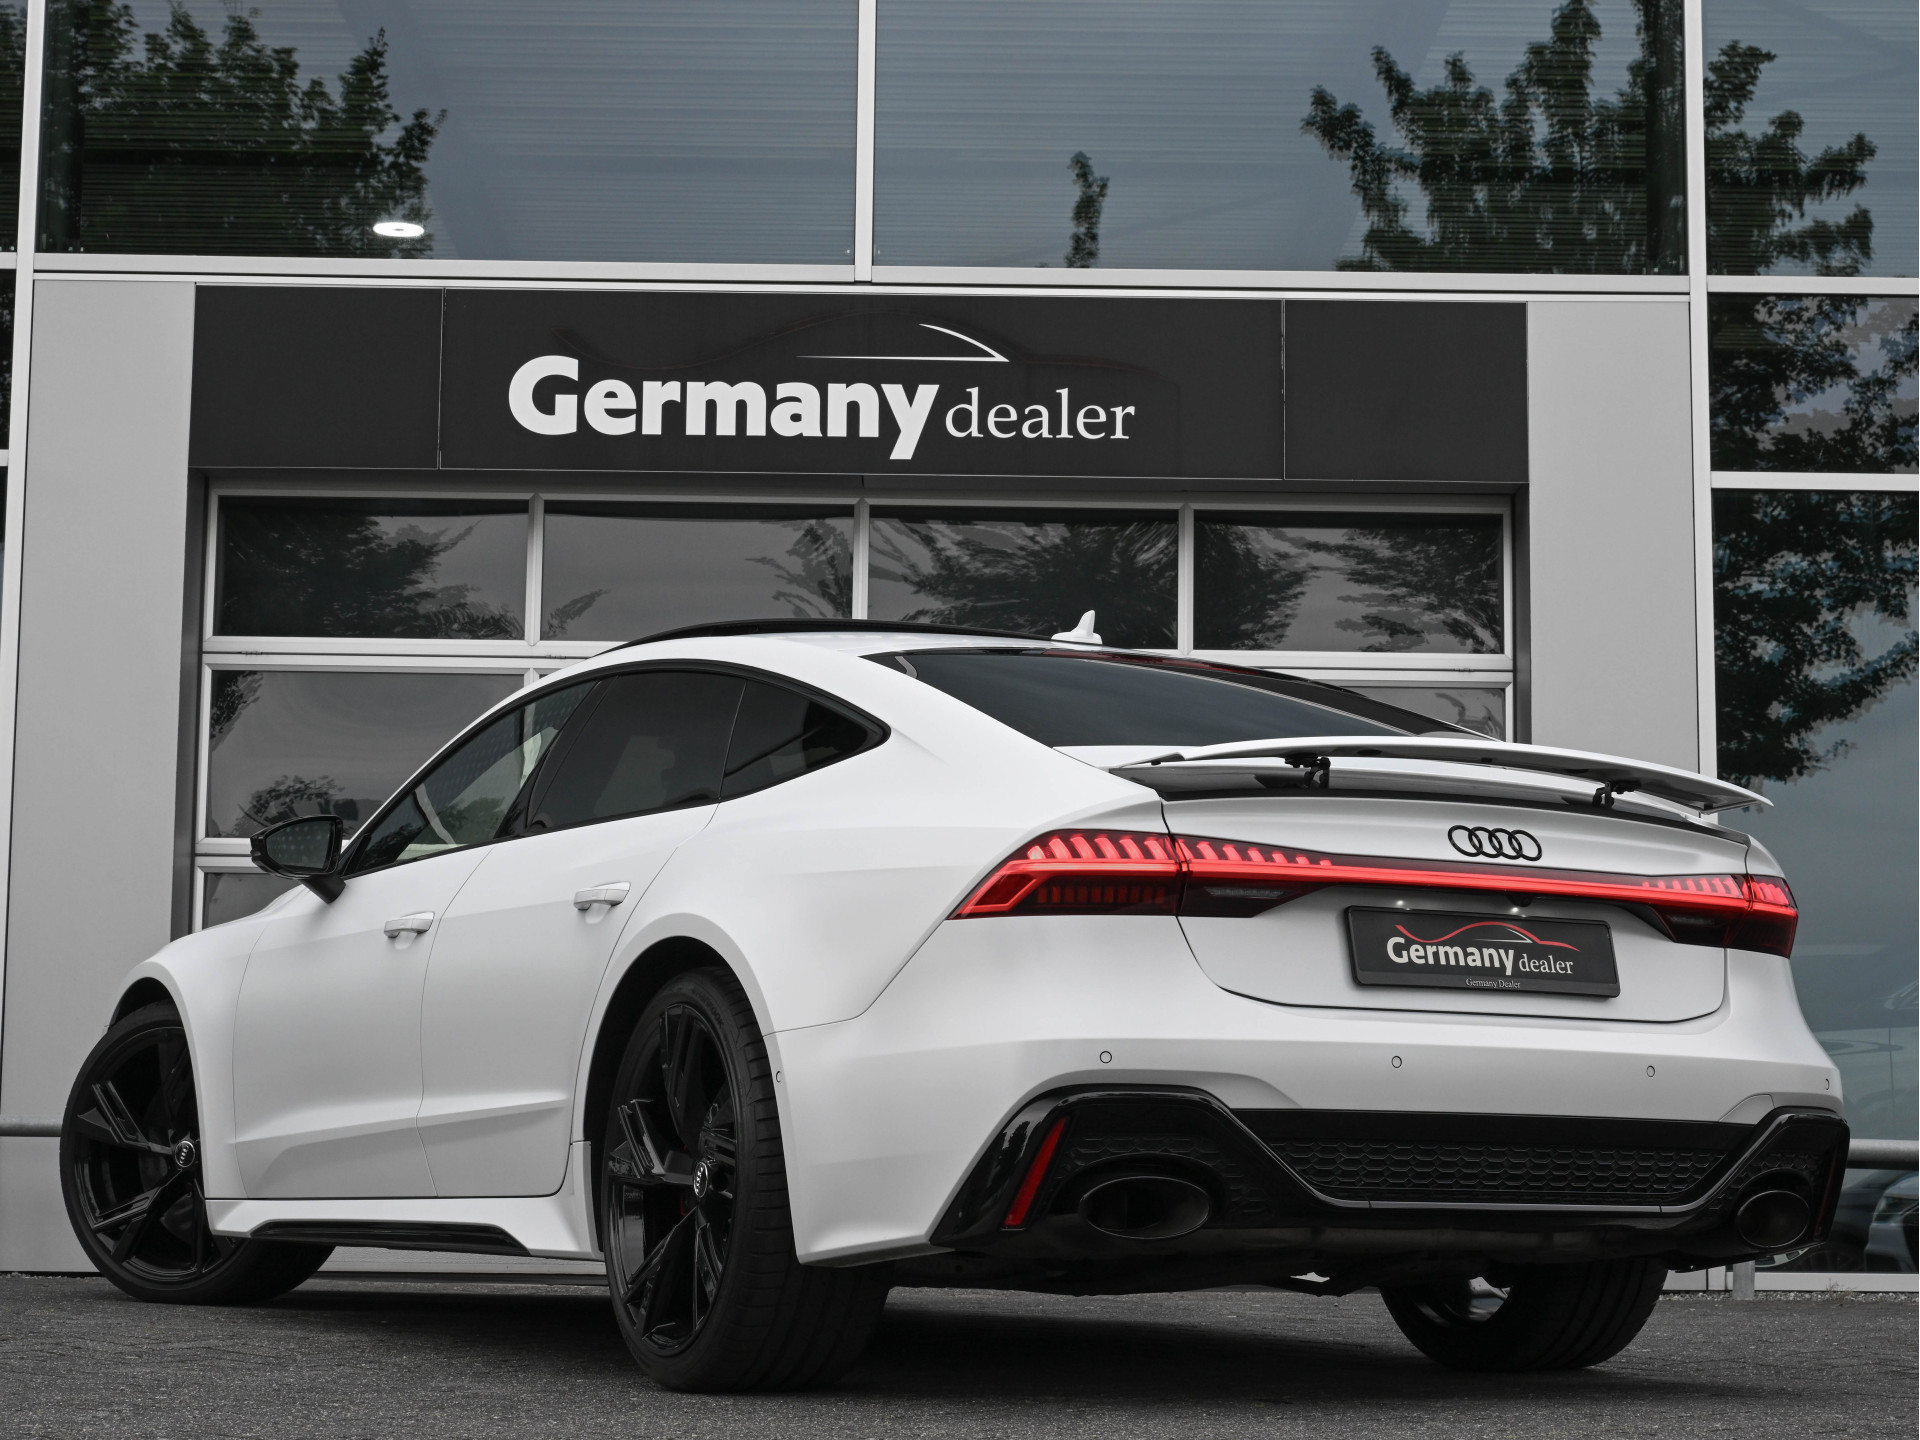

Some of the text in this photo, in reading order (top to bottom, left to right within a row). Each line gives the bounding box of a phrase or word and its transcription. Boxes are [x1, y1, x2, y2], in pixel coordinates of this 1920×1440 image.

[508, 355, 1136, 460] Germany dealer
[1386, 937, 1574, 975] Germany dealer
[1465, 978, 1521, 989] Germany Dealer
